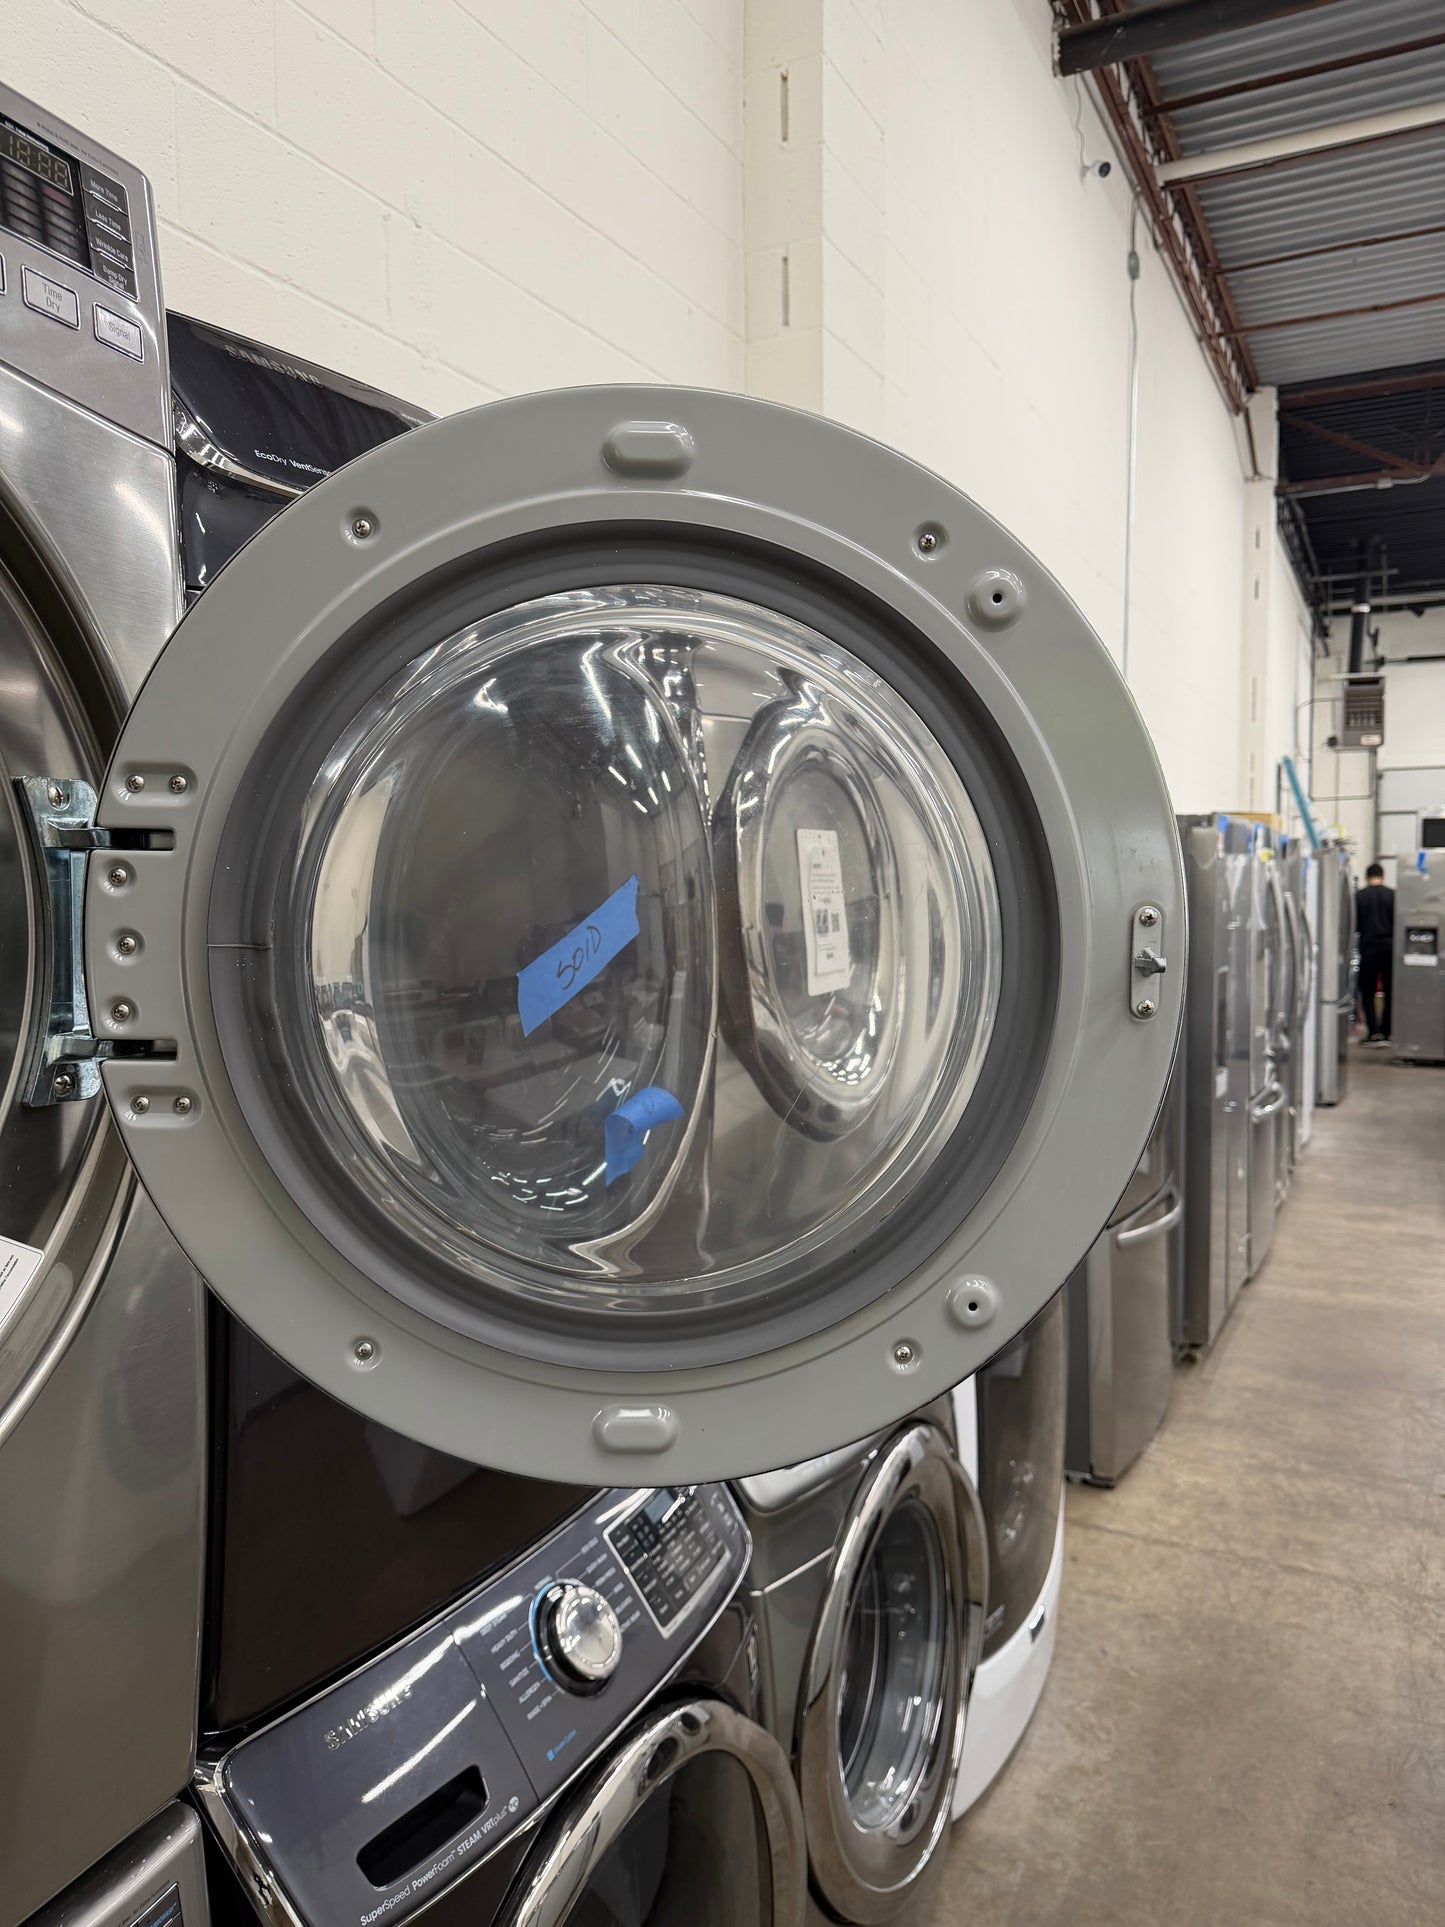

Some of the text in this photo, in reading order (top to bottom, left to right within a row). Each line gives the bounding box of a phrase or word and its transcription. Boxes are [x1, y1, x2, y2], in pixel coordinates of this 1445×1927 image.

[42, 282, 63, 302] Time
[46, 297, 61, 314] Dry
[108, 320, 131, 341] Signal
[254, 449, 287, 466] EcoDry
[360, 1886, 411, 1927] SuperSpeed
[456, 1831, 482, 1856] STEAM
